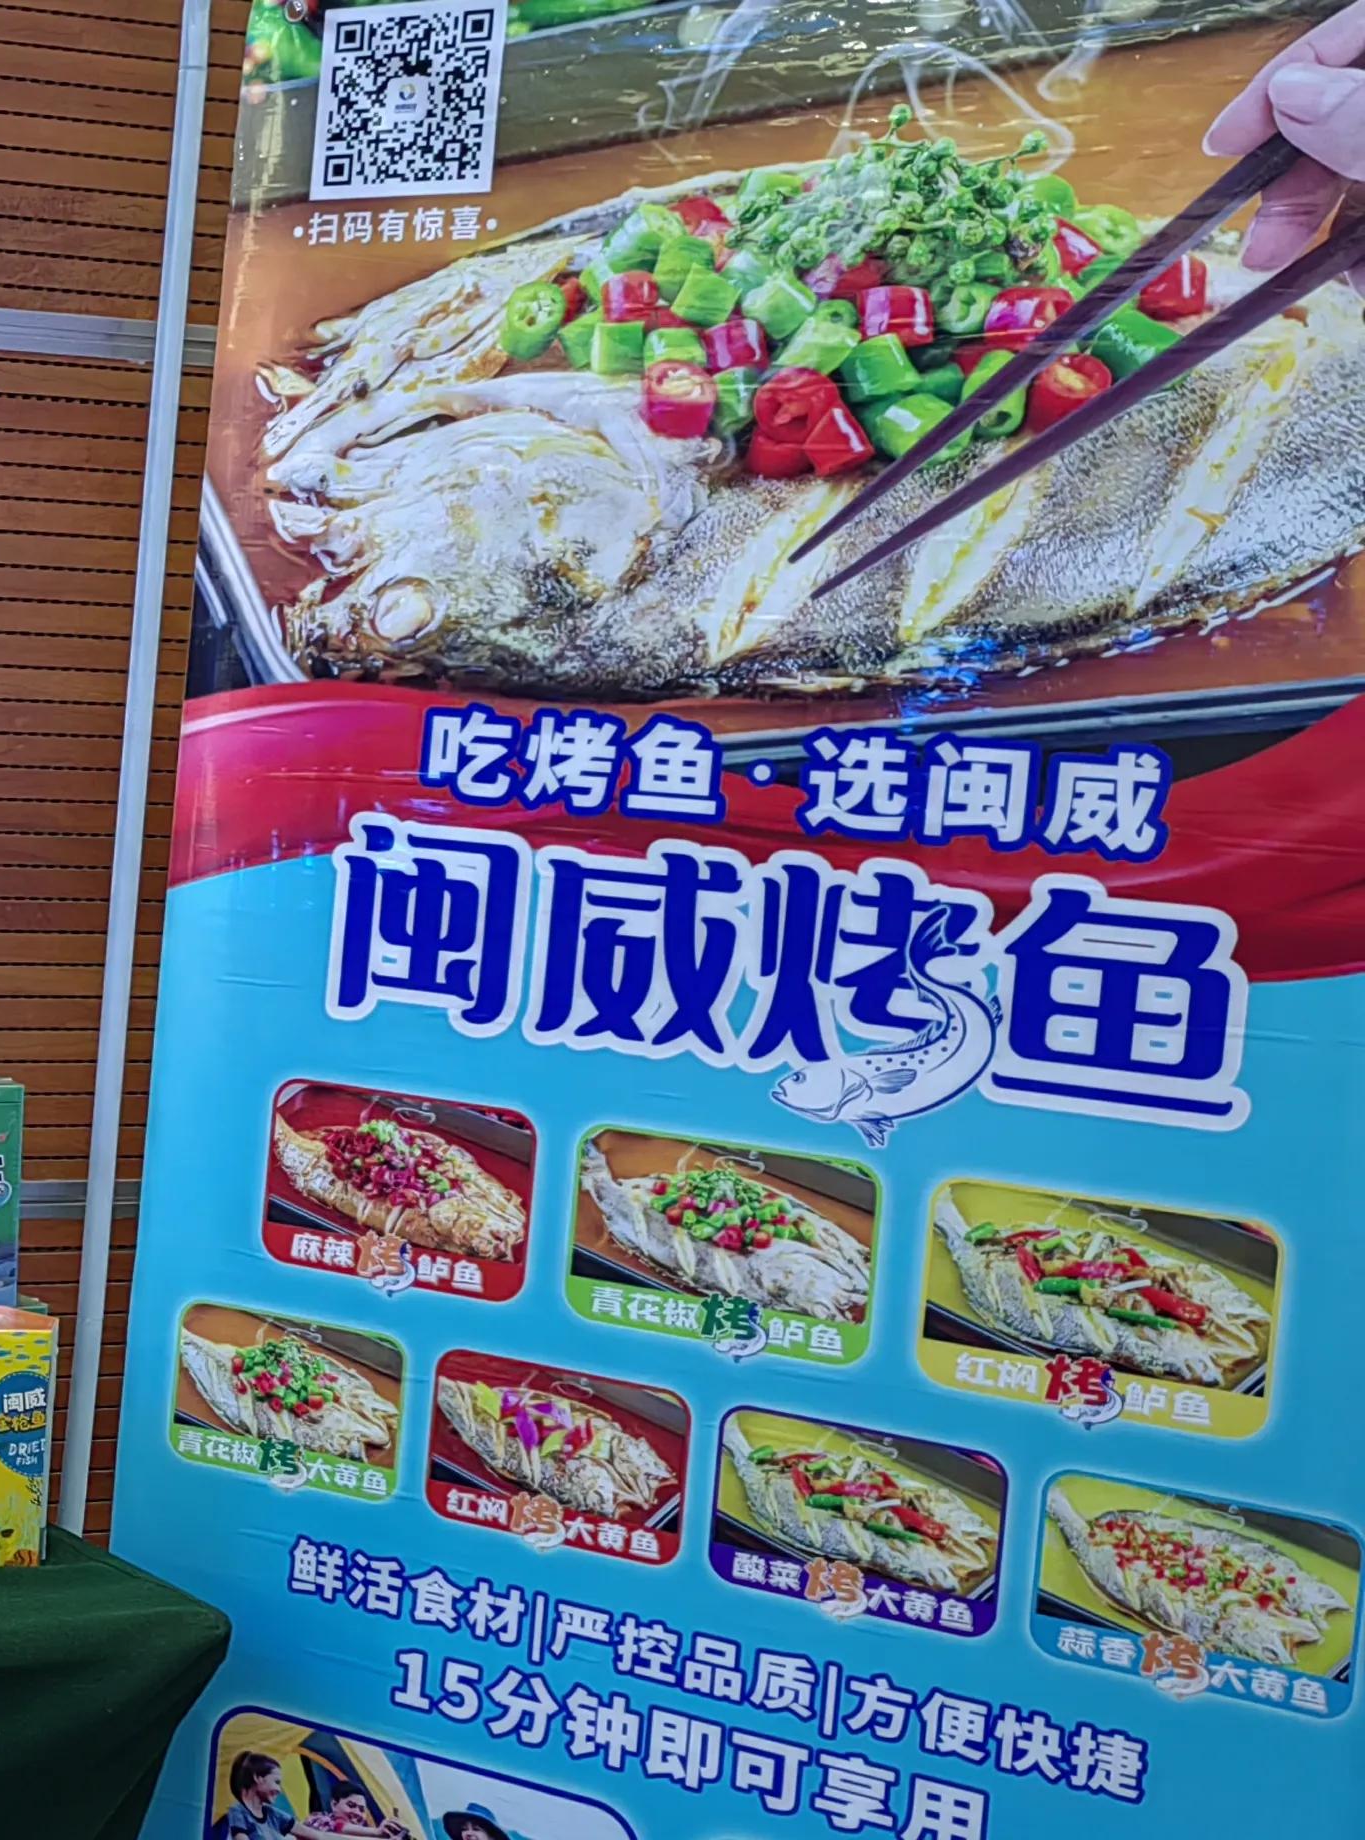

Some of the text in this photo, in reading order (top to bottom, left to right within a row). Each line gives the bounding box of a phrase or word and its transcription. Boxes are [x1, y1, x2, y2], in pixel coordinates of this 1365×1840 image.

[335, 818, 1244, 1120] 闽威烤鱼
[2, 1387, 47, 1414] 闽威
[393, 1650, 988, 1840] 15分钟即可享用
